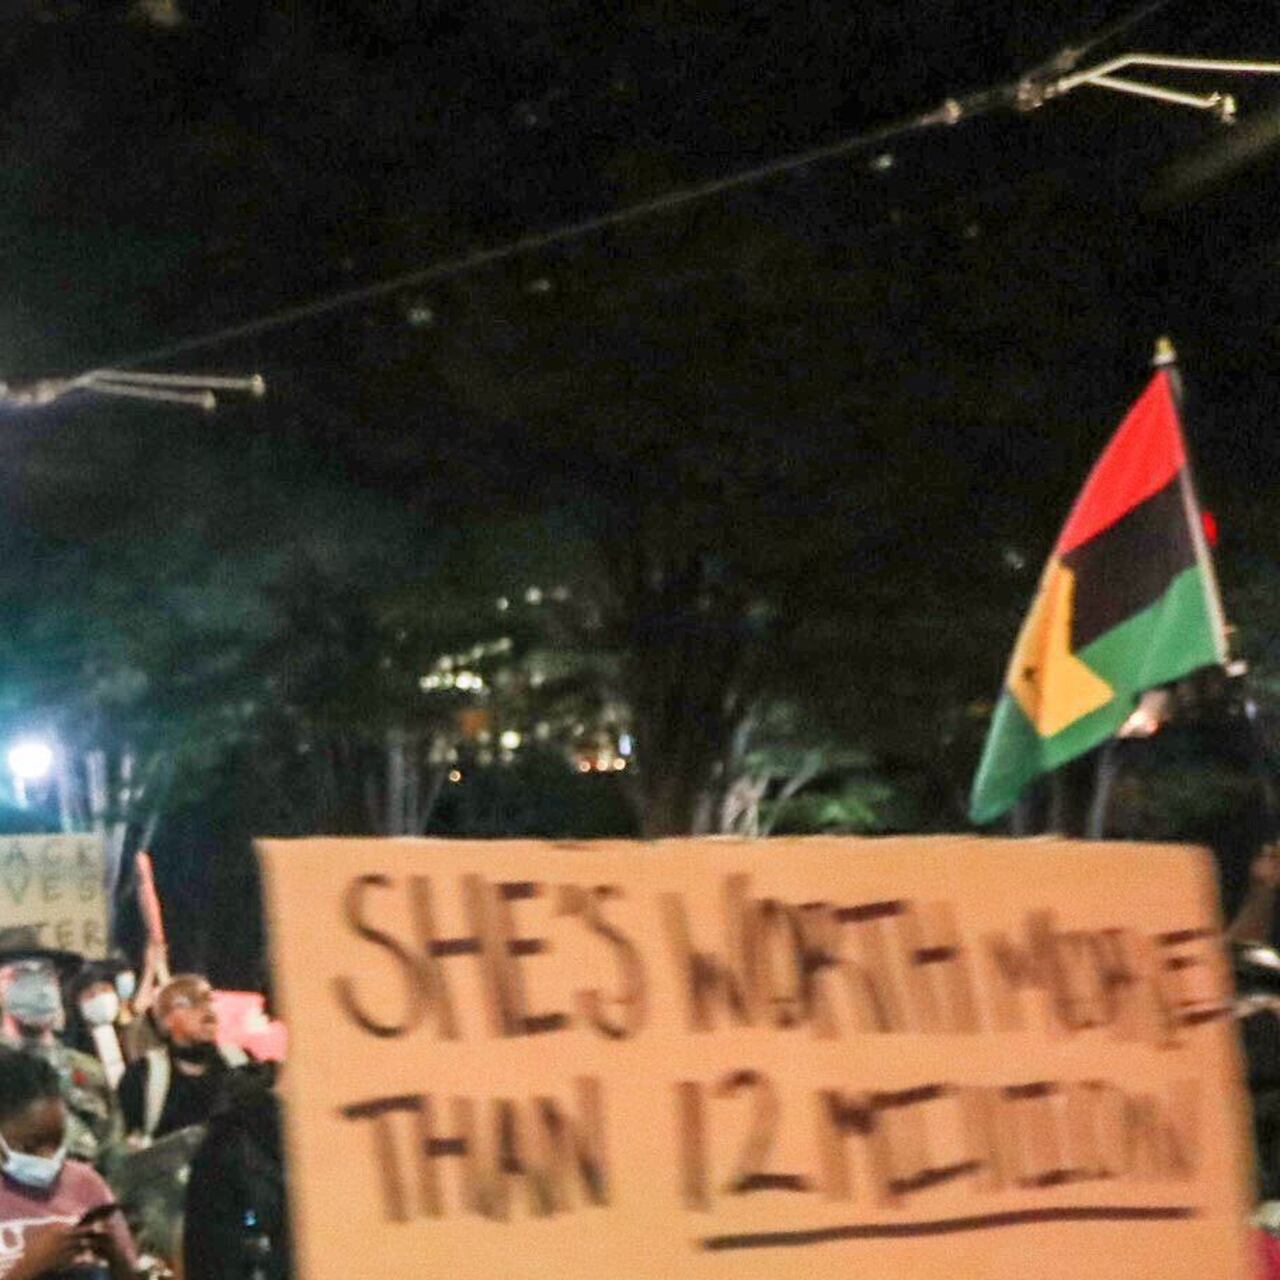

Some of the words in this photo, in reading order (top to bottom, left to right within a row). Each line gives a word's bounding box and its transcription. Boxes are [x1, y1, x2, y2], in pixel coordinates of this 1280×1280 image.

[330, 870, 649, 1041] SHE'S
[336, 1073, 611, 1225] THAN
[673, 1067, 815, 1214] 12
